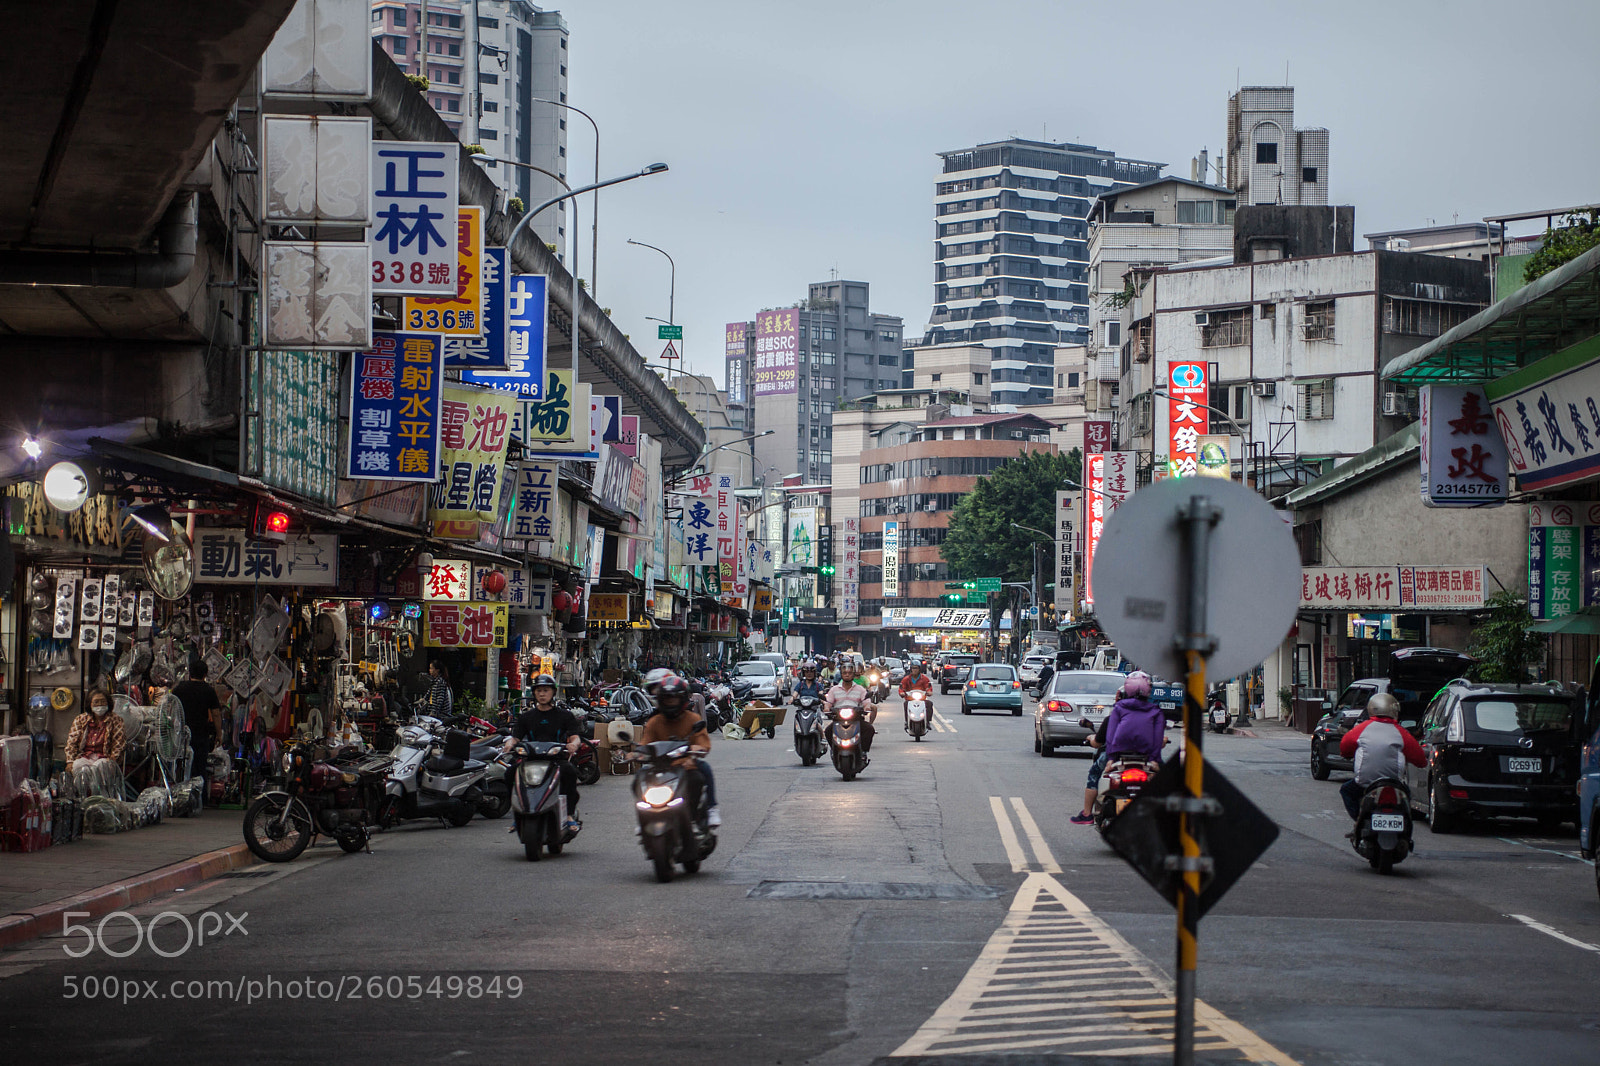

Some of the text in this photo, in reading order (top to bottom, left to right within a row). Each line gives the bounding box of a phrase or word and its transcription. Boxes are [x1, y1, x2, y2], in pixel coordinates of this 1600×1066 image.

[374, 150, 448, 256] 正林
[372, 260, 451, 286] 338號
[409, 309, 475, 329] 336號
[757, 335, 795, 352] 超越SRC
[360, 336, 397, 400] 空壓機
[756, 369, 795, 383] 2991-2999
[396, 338, 435, 473] 雷射水平儀
[441, 399, 508, 453] 電池
[530, 372, 570, 437] 瑞
[357, 408, 392, 471] 割草機
[1448, 391, 1499, 484] 嘉政
[1436, 484, 1500, 495] 23145776
[515, 515, 552, 538] 五金
[687, 500, 715, 561] 東洋
[1060, 520, 1073, 589] 馬可貝里磁磚
[426, 563, 460, 600] 發
[1401, 568, 1414, 603] 金龍
[428, 603, 495, 646] 電池
